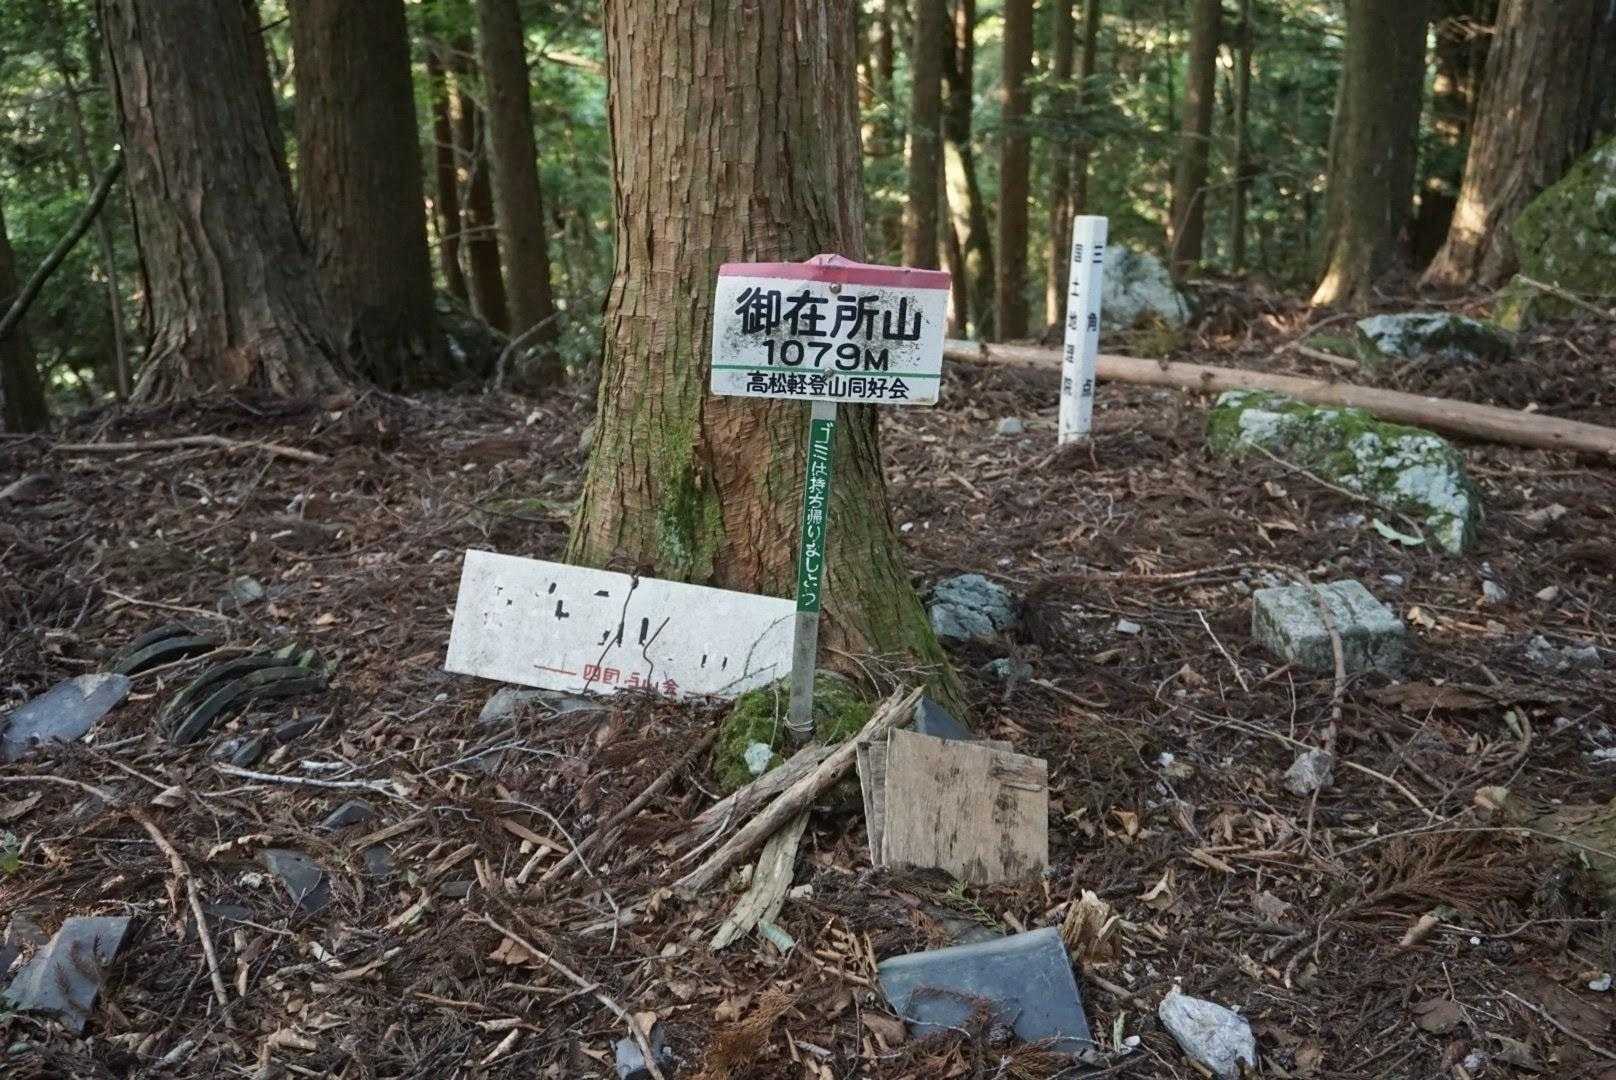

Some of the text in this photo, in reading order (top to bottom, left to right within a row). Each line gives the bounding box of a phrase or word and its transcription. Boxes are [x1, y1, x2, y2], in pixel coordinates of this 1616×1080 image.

[735, 286, 922, 341] 御在所山
[1081, 245, 1104, 397] 三角点
[762, 339, 889, 371] 1079M
[746, 371, 910, 399] 高松軽登山同好会
[801, 422, 834, 606] ゴミは持ち帰りましょう
